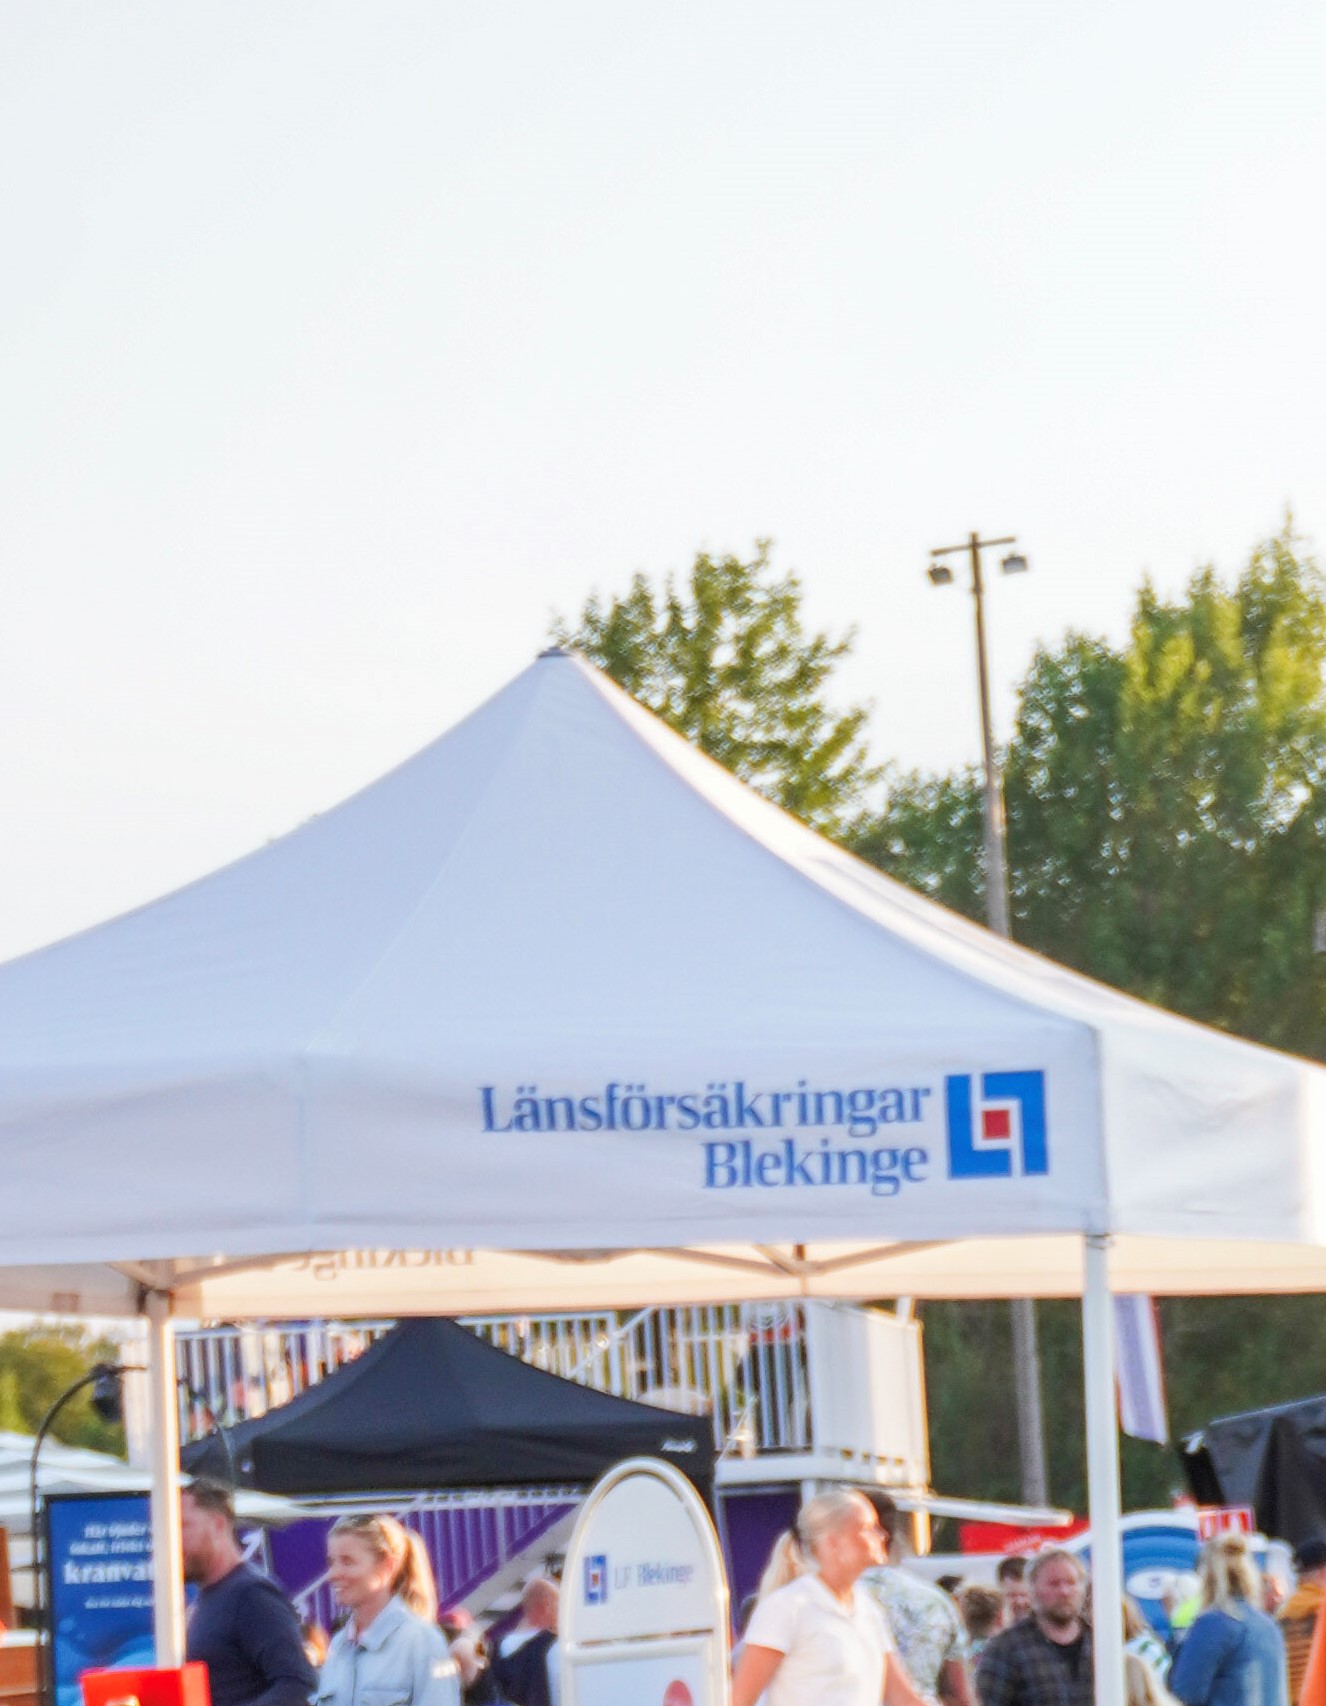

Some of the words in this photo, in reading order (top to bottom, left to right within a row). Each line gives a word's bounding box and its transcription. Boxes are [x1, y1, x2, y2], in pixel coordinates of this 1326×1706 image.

[477, 1080, 932, 1139] Länsförsäkringar
[701, 1138, 929, 1197] Blekinge
[637, 1563, 694, 1588] Blekinge
